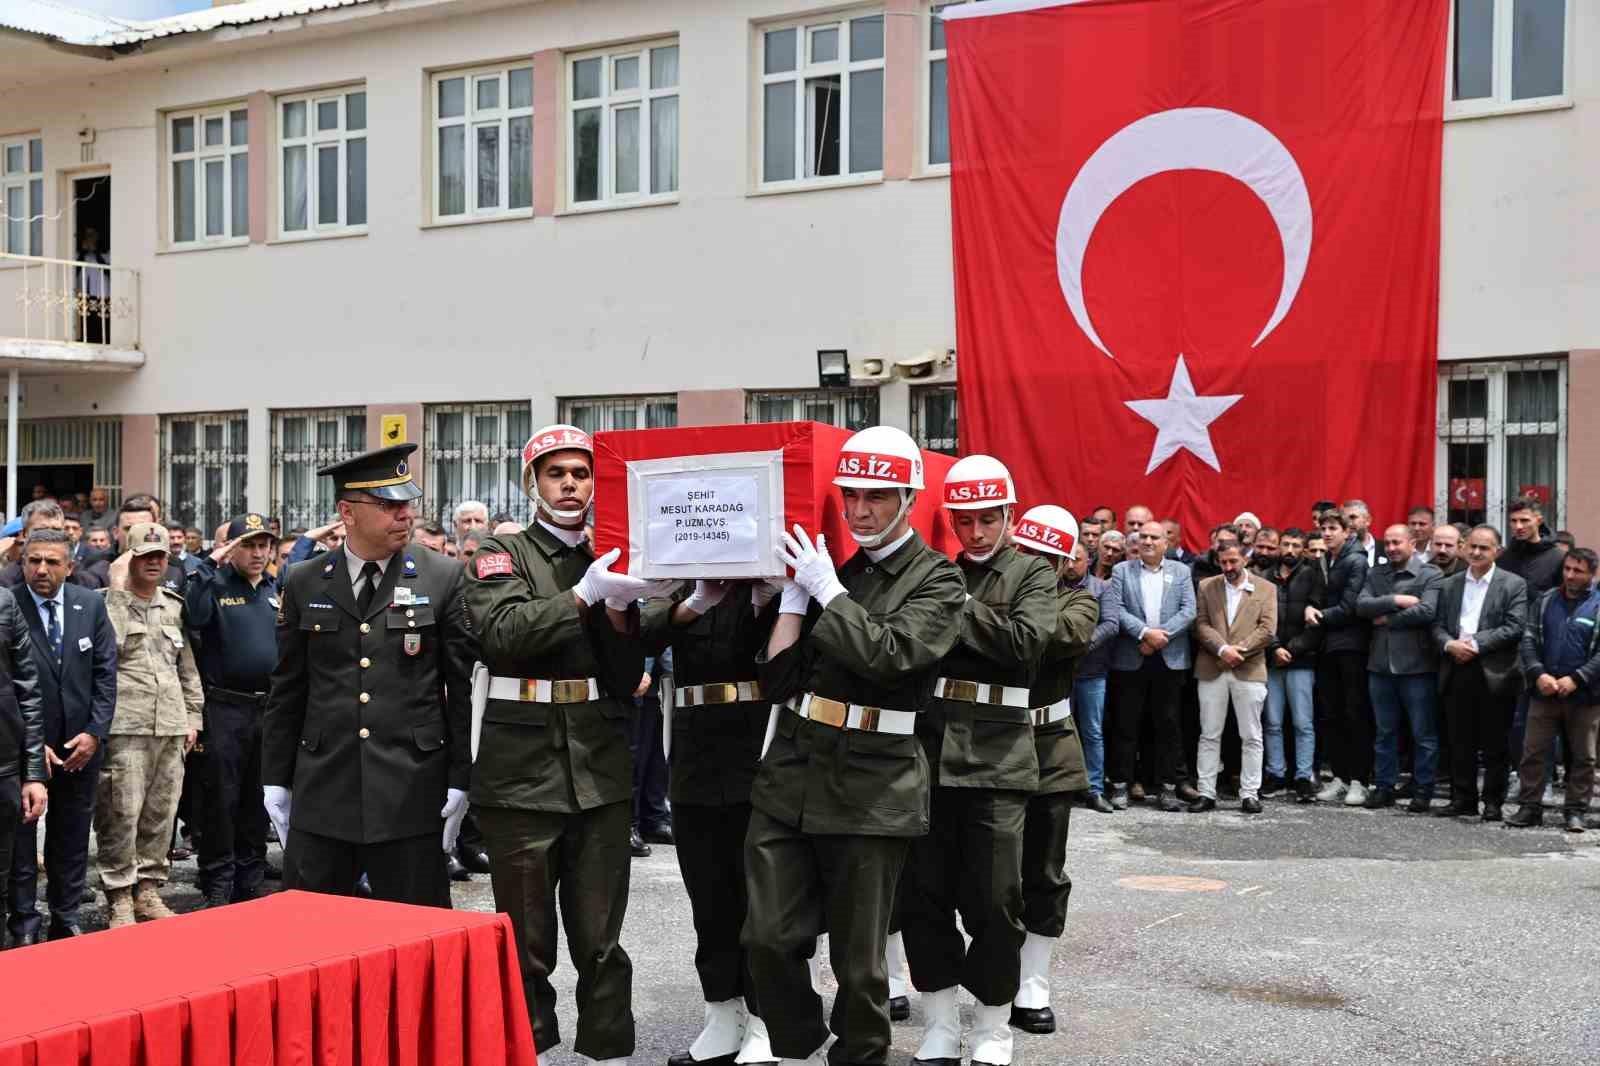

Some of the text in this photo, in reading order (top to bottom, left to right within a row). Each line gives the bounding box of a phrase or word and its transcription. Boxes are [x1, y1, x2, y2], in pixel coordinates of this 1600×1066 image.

[838, 456, 898, 479] AS.İZ.
[949, 483, 1002, 500] AS.İZ.
[660, 502, 743, 514] MESUT KARADAĞ
[675, 531, 730, 543] (2019-14345)
[1020, 524, 1063, 548] AS.İZ.
